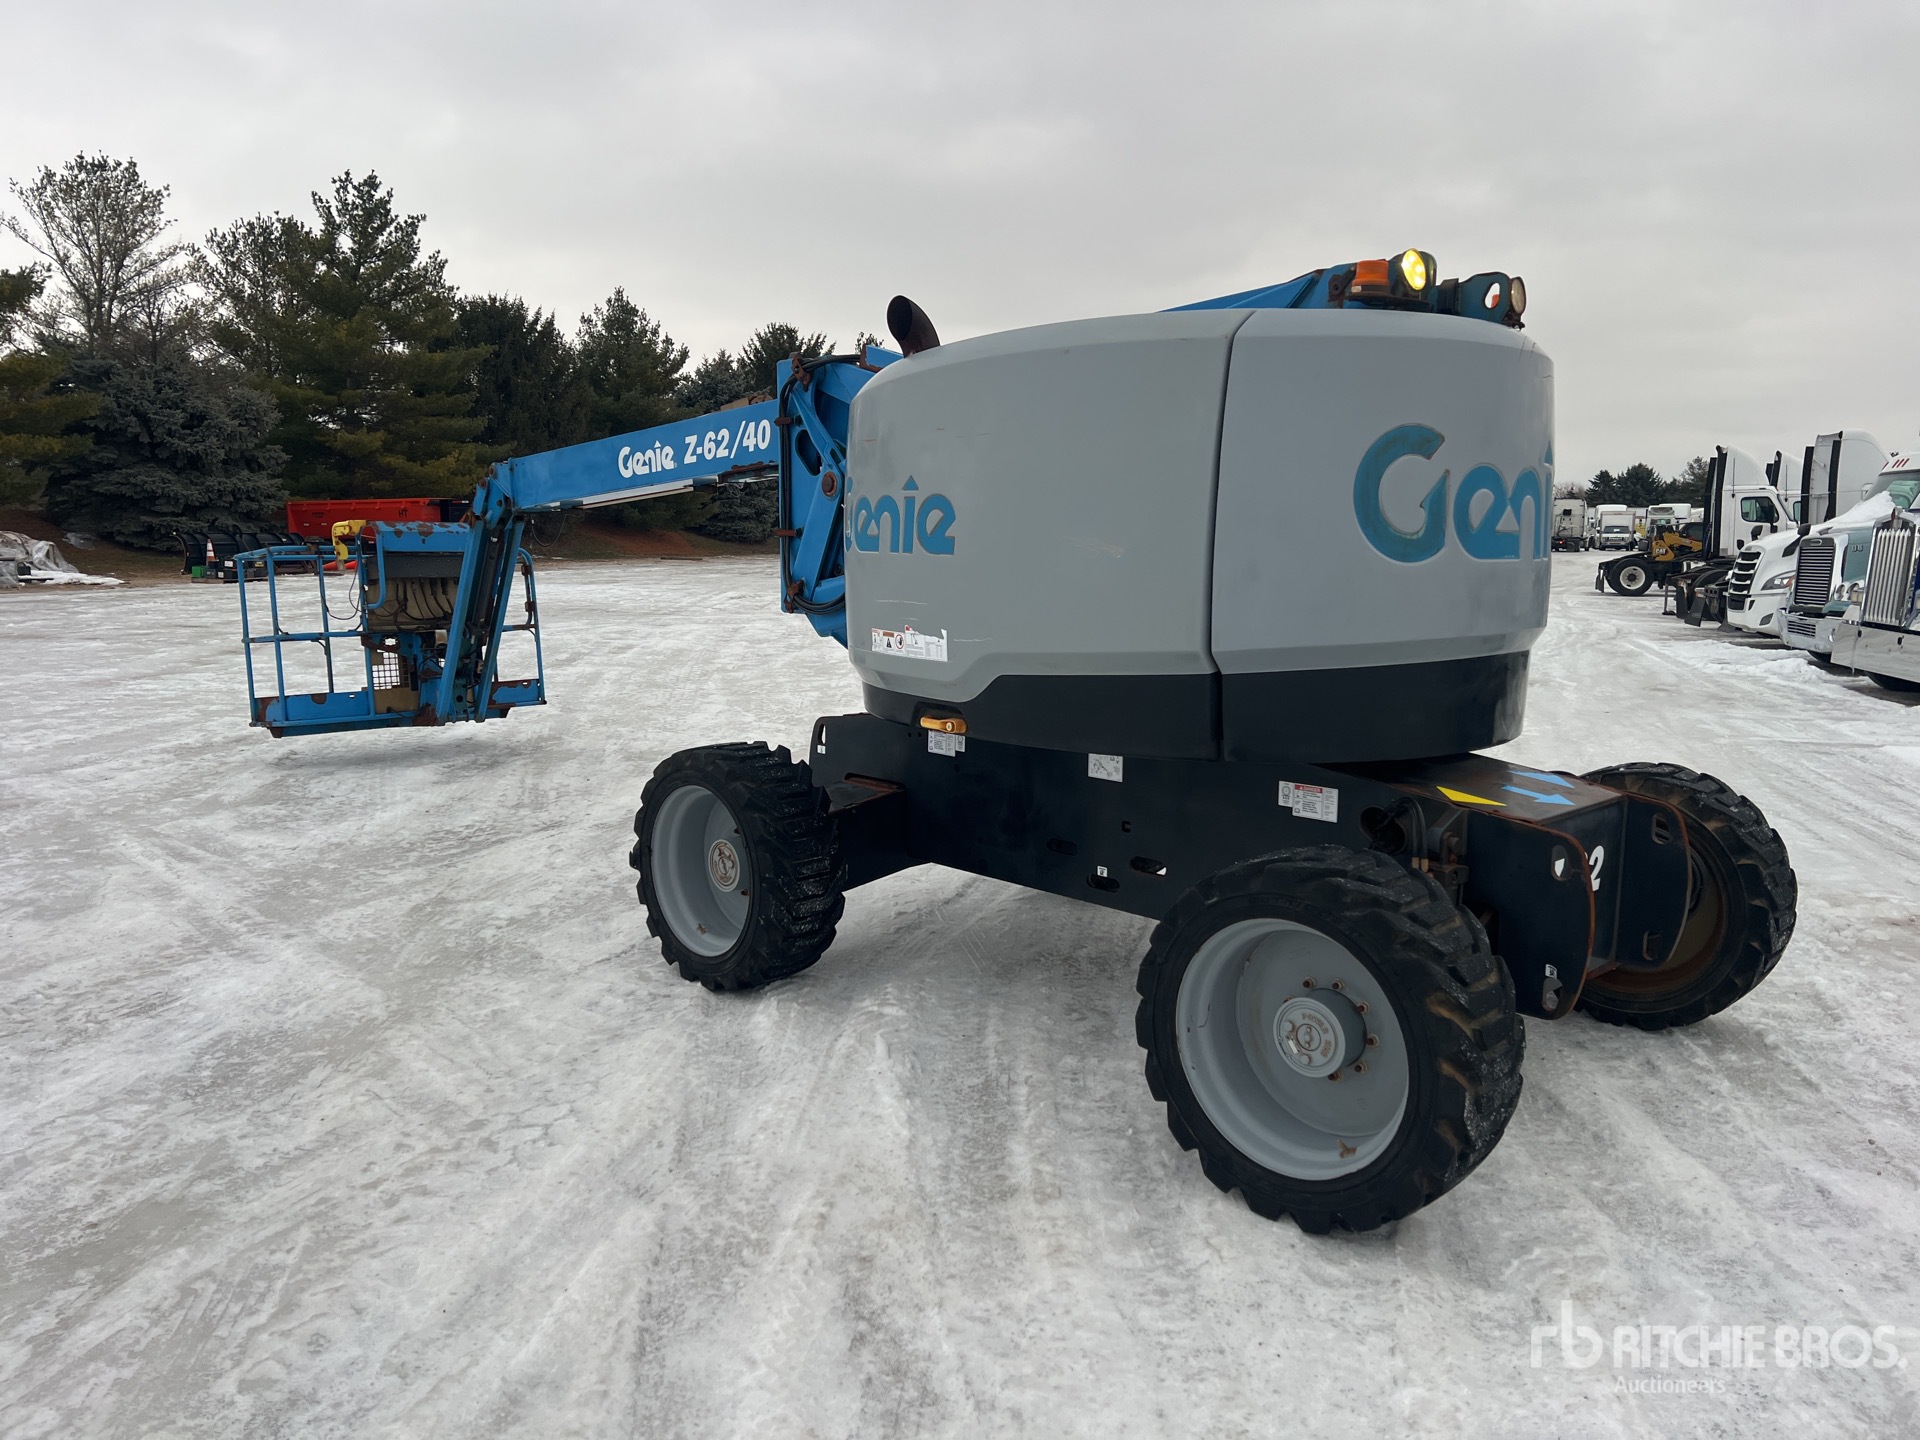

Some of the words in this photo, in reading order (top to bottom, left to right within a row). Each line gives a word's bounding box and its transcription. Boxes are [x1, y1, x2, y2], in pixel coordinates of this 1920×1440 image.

[618, 440, 675, 478] Genie
[684, 419, 771, 464] Z-62/40
[1584, 845, 1605, 892] 2
